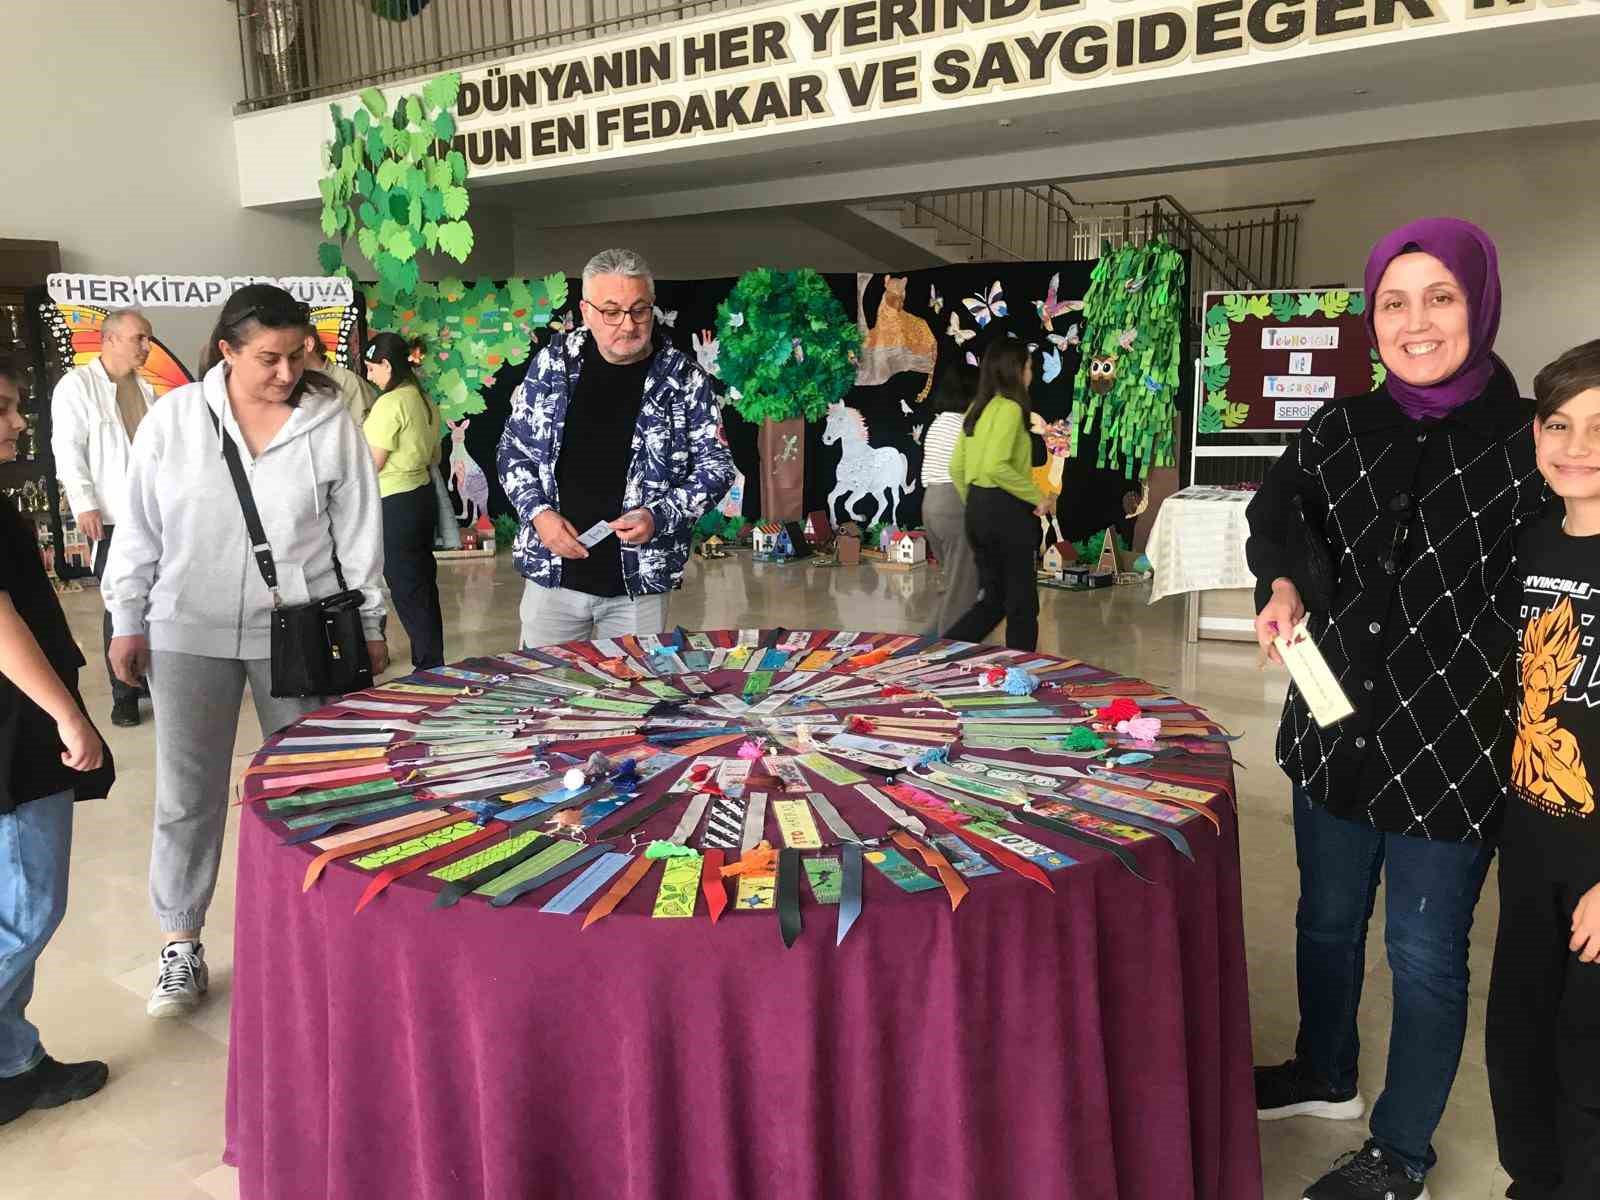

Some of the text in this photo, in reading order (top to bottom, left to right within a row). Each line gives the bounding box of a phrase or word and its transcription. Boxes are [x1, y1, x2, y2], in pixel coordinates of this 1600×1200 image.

[457, 42, 671, 116] DÜNYANIN
[684, 20, 789, 76] HER
[531, 115, 585, 156] EN
[597, 75, 825, 146] FEDAKAR
[838, 55, 918, 107] VE
[1523, 575, 1590, 595] NVINCIBLE
